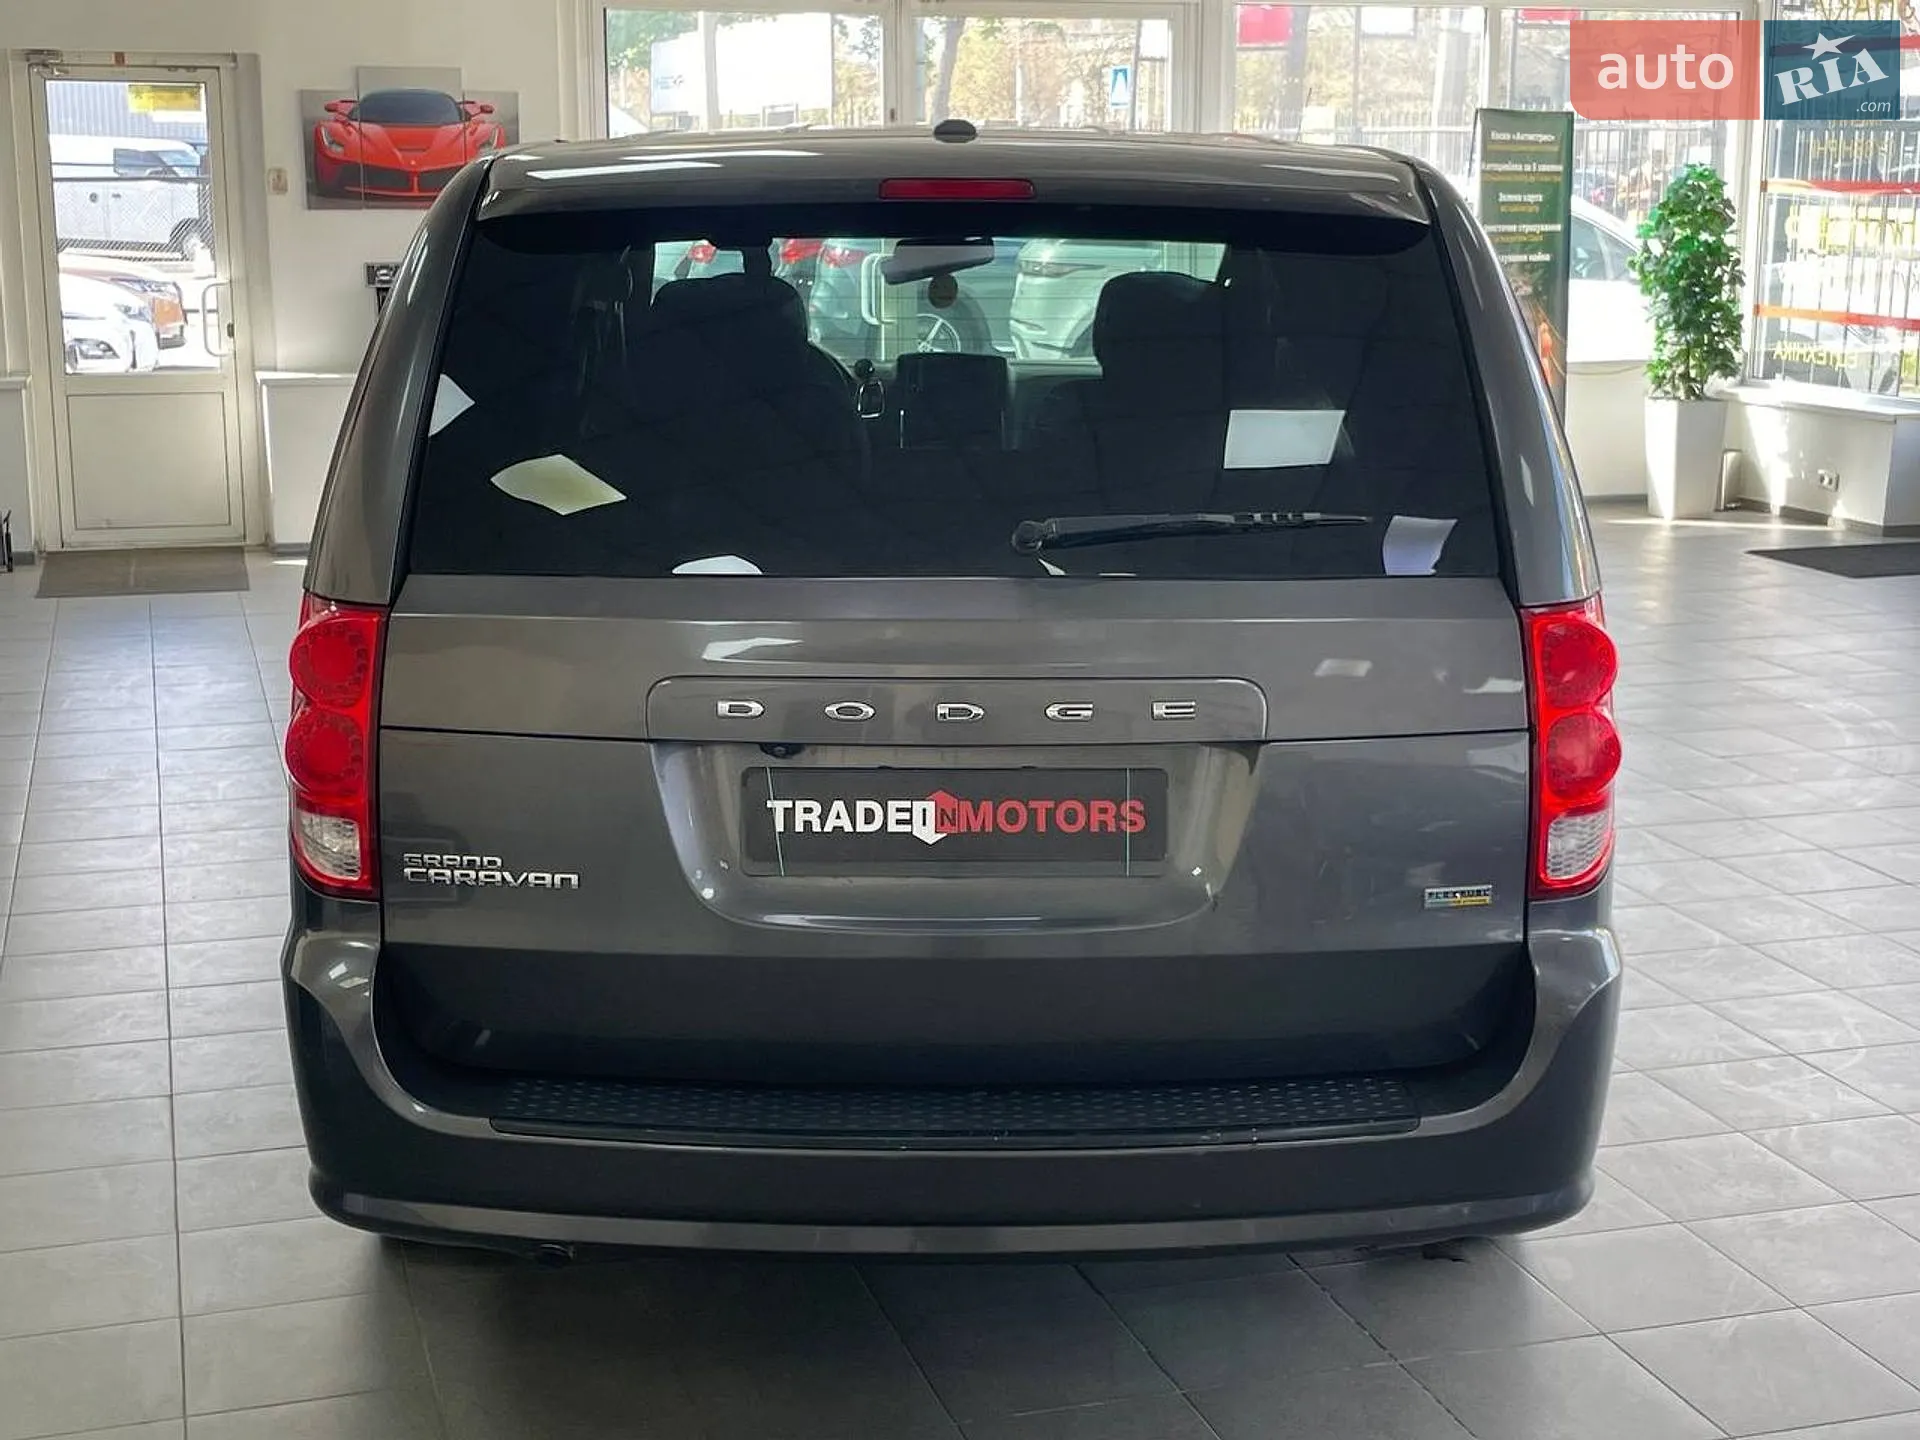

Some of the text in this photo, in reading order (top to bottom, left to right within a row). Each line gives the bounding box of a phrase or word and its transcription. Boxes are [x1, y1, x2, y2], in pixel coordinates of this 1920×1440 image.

[716, 699, 1196, 723] DODGE
[403, 853, 503, 869] GRAND
[403, 867, 580, 890] CARAVAN
